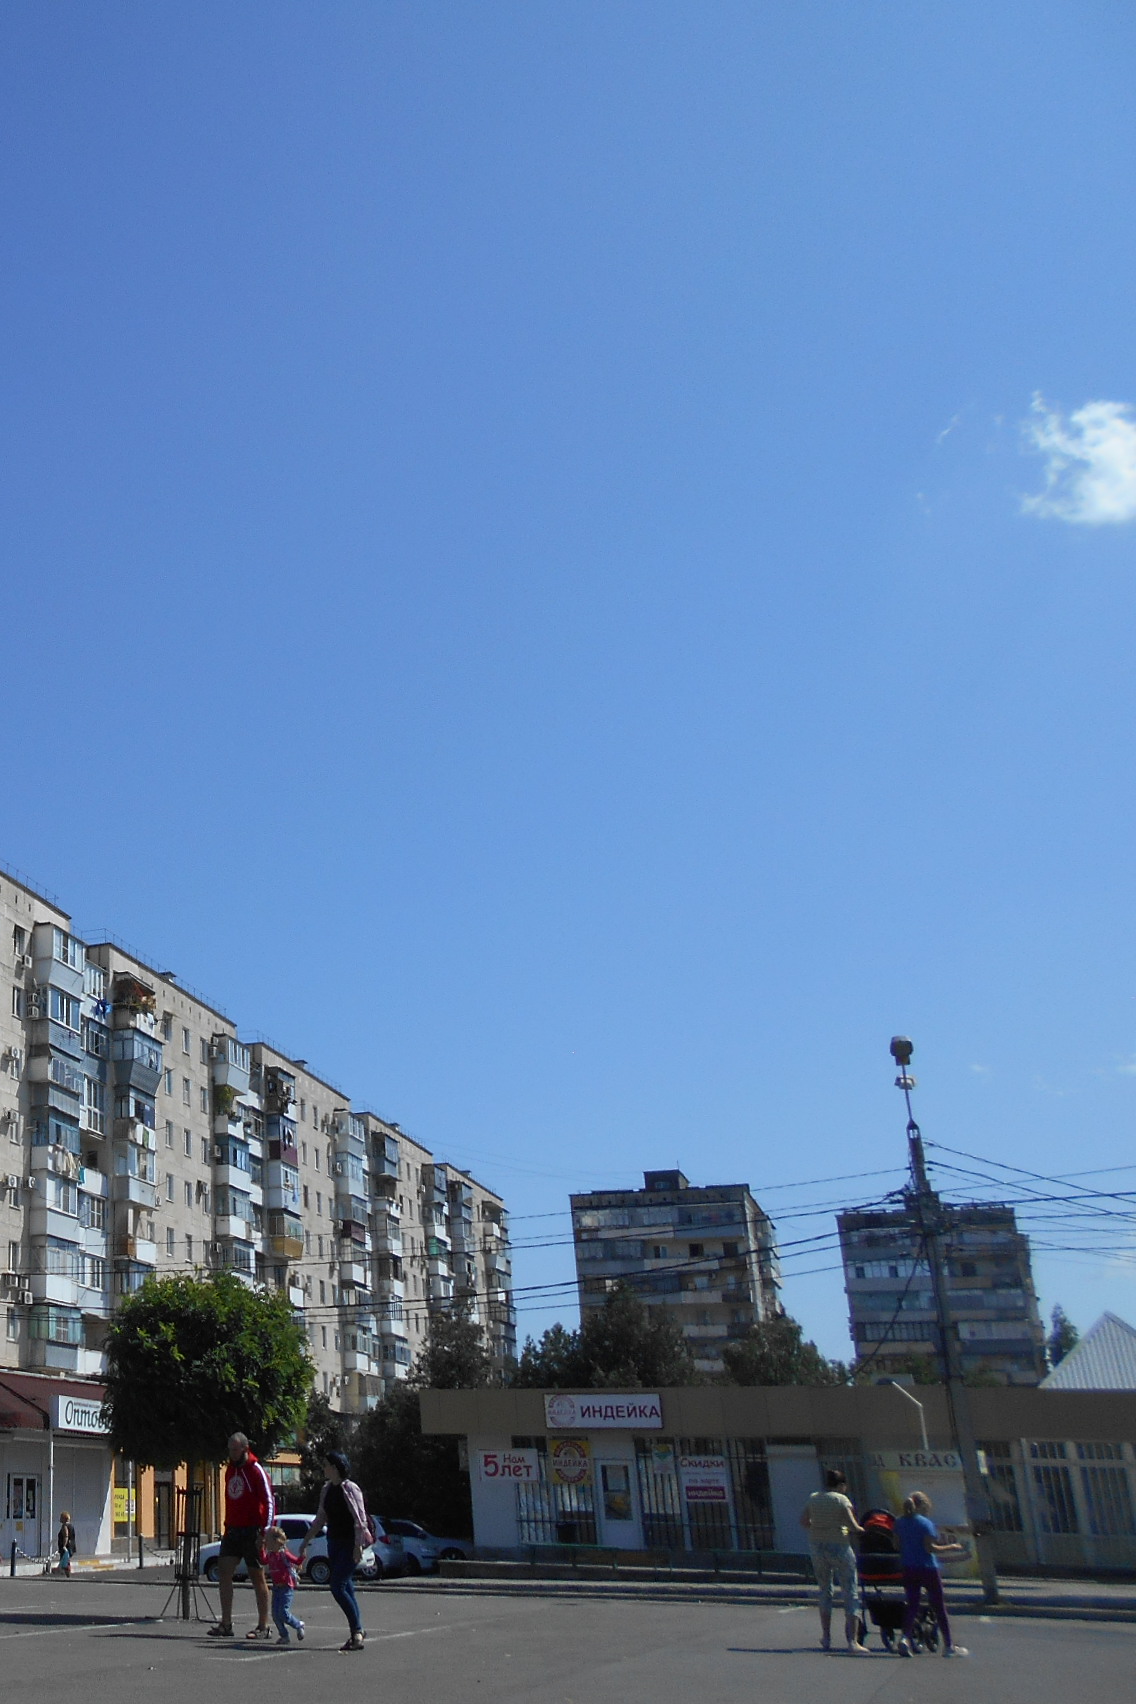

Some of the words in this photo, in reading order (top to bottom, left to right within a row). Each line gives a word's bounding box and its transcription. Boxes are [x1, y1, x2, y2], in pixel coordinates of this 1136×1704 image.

[580, 1403, 661, 1420] ИНДЕЙКА
[484, 1454, 500, 1477] 5
[504, 1453, 526, 1464] Нам
[679, 1457, 724, 1468] Скидки
[898, 1453, 957, 1468] КВАС
[500, 1464, 533, 1477] лет
